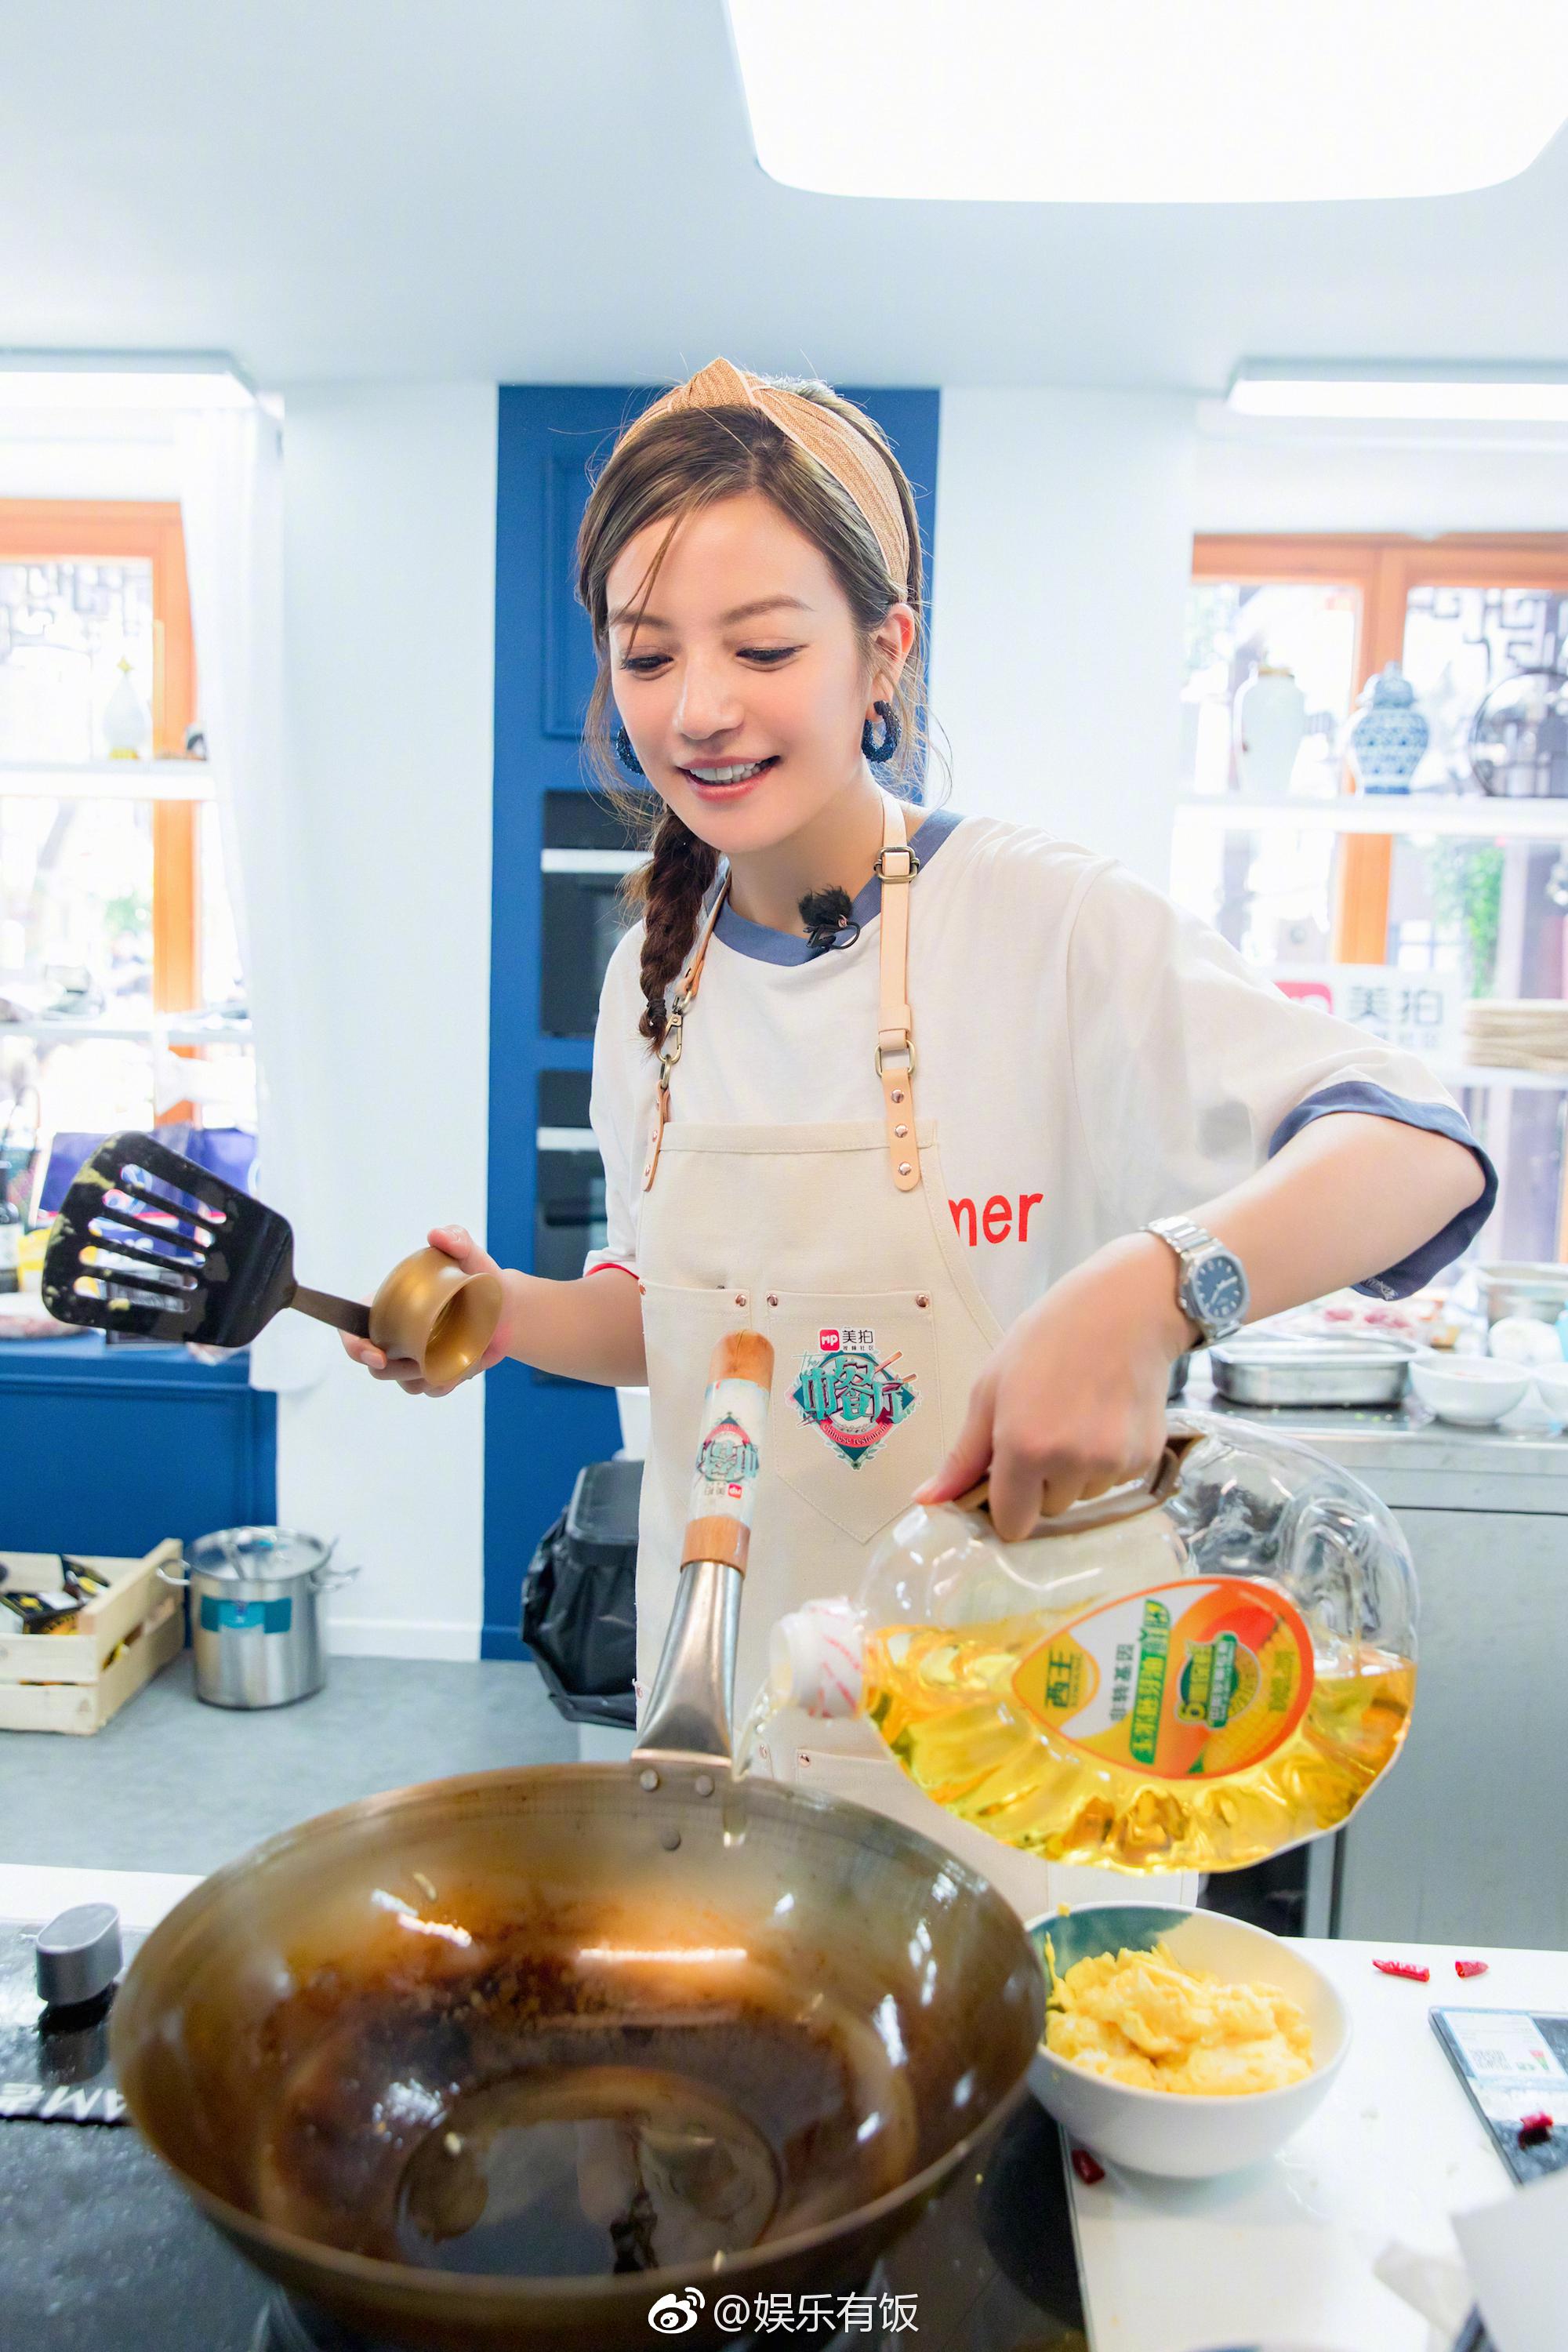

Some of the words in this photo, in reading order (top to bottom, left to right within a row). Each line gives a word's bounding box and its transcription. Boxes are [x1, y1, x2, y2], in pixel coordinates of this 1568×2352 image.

[1346, 985, 1444, 1026] 美拍
[842, 1330, 873, 1344] 美拍
[800, 1356, 903, 1424] 中餐厅
[822, 1422, 851, 1444] Chinese
[853, 1421, 889, 1445] restaurant
[1044, 1646, 1072, 1708] 西王
[1109, 1643, 1135, 1722] 非转基因
